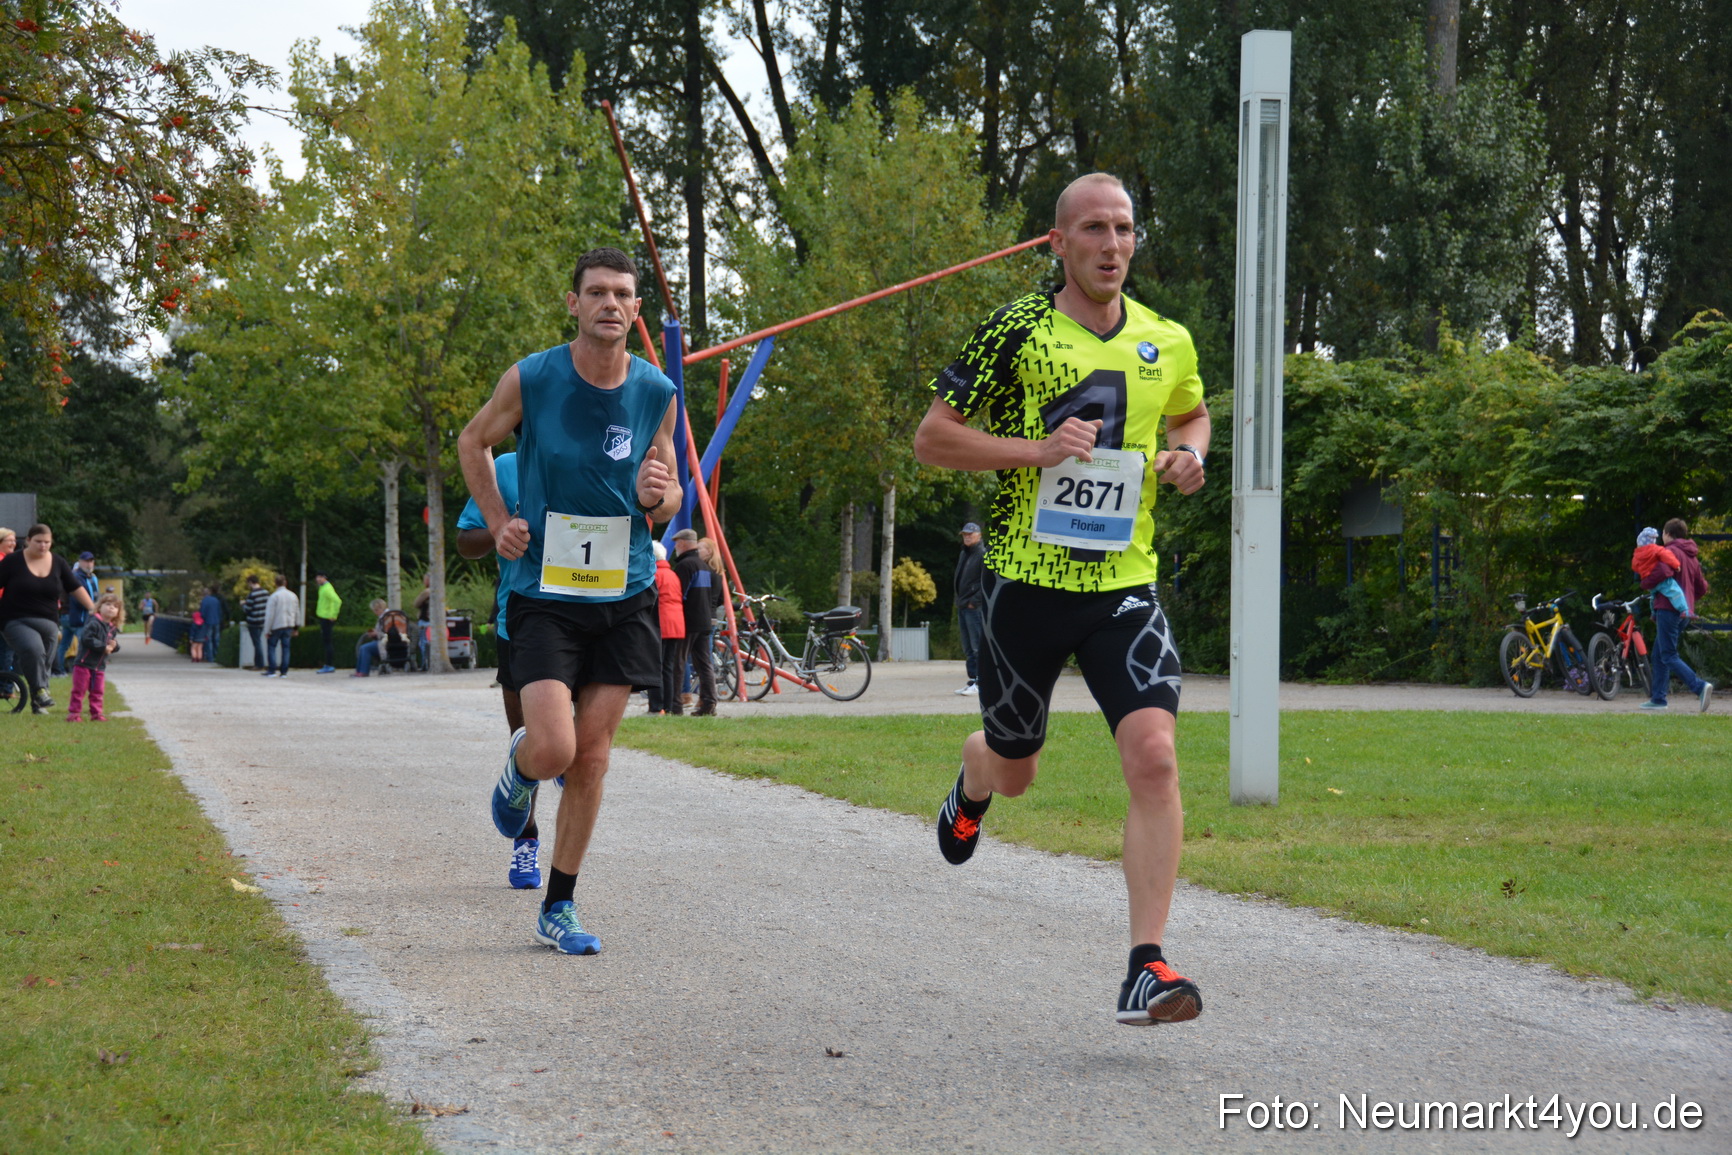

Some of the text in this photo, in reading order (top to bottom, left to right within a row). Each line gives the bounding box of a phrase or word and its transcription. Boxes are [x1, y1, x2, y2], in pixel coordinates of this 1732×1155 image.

[1138, 365, 1163, 377] Partl
[1053, 476, 1125, 511] 2671
[579, 523, 609, 531] BOCK
[1070, 518, 1106, 532] Florian
[581, 541, 592, 565] 1
[571, 572, 600, 583] Stefan
